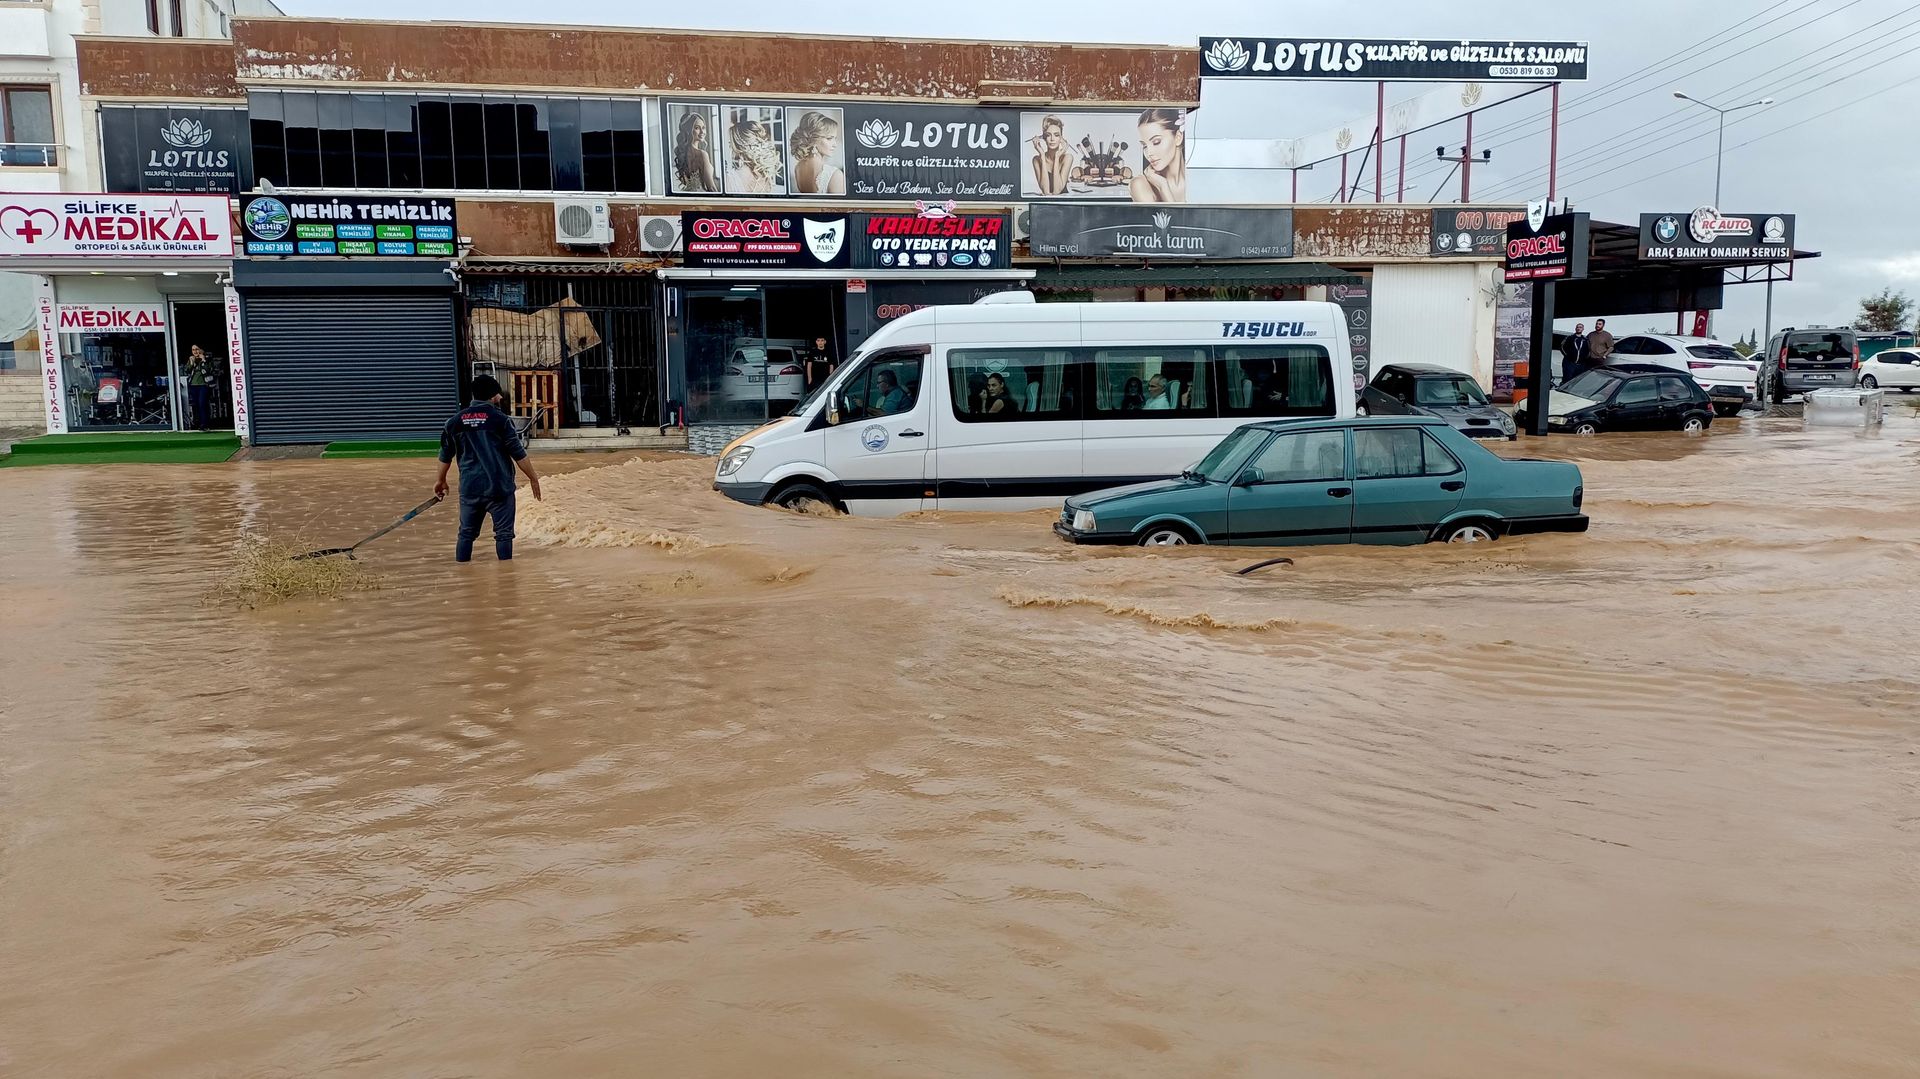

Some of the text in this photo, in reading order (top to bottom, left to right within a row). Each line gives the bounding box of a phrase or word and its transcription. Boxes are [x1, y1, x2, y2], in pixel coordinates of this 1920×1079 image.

[1252, 40, 1585, 72] LOTUS KUAFÖR ve GÜZELLİK SALONU
[900, 122, 1010, 148] LOTUS
[148, 150, 229, 168] LOTUS
[856, 156, 1010, 168] KUAFÖR ve GÜZELLİK SALONU
[936, 182, 953, 194] Size
[64, 200, 138, 214] SİLİFKE
[290, 198, 452, 220] NEHİR TEMİZLİK
[64, 210, 219, 240] MEDİKAL
[254, 223, 282, 231] NEHİR
[1456, 212, 1483, 230] OTO
[1702, 220, 1750, 229] RC AUTO
[74, 242, 120, 250] ORTOPEDİ
[130, 242, 161, 250] SAĞLIK
[163, 242, 207, 250] ÜRÜNLERİ
[872, 238, 997, 252] OTO YEDEK PARÇA
[1116, 232, 1204, 252] toprak tarım
[1246, 246, 1260, 255] (542)
[1648, 247, 1674, 258] ARAÇ
[1676, 248, 1708, 258] BAKIM
[1710, 247, 1750, 258] ONARIM
[60, 306, 165, 327] MEDİKAL
[877, 304, 912, 318] OTO
[41, 306, 54, 364] SİLİFKE
[1222, 322, 1304, 339] TAŞUCU
